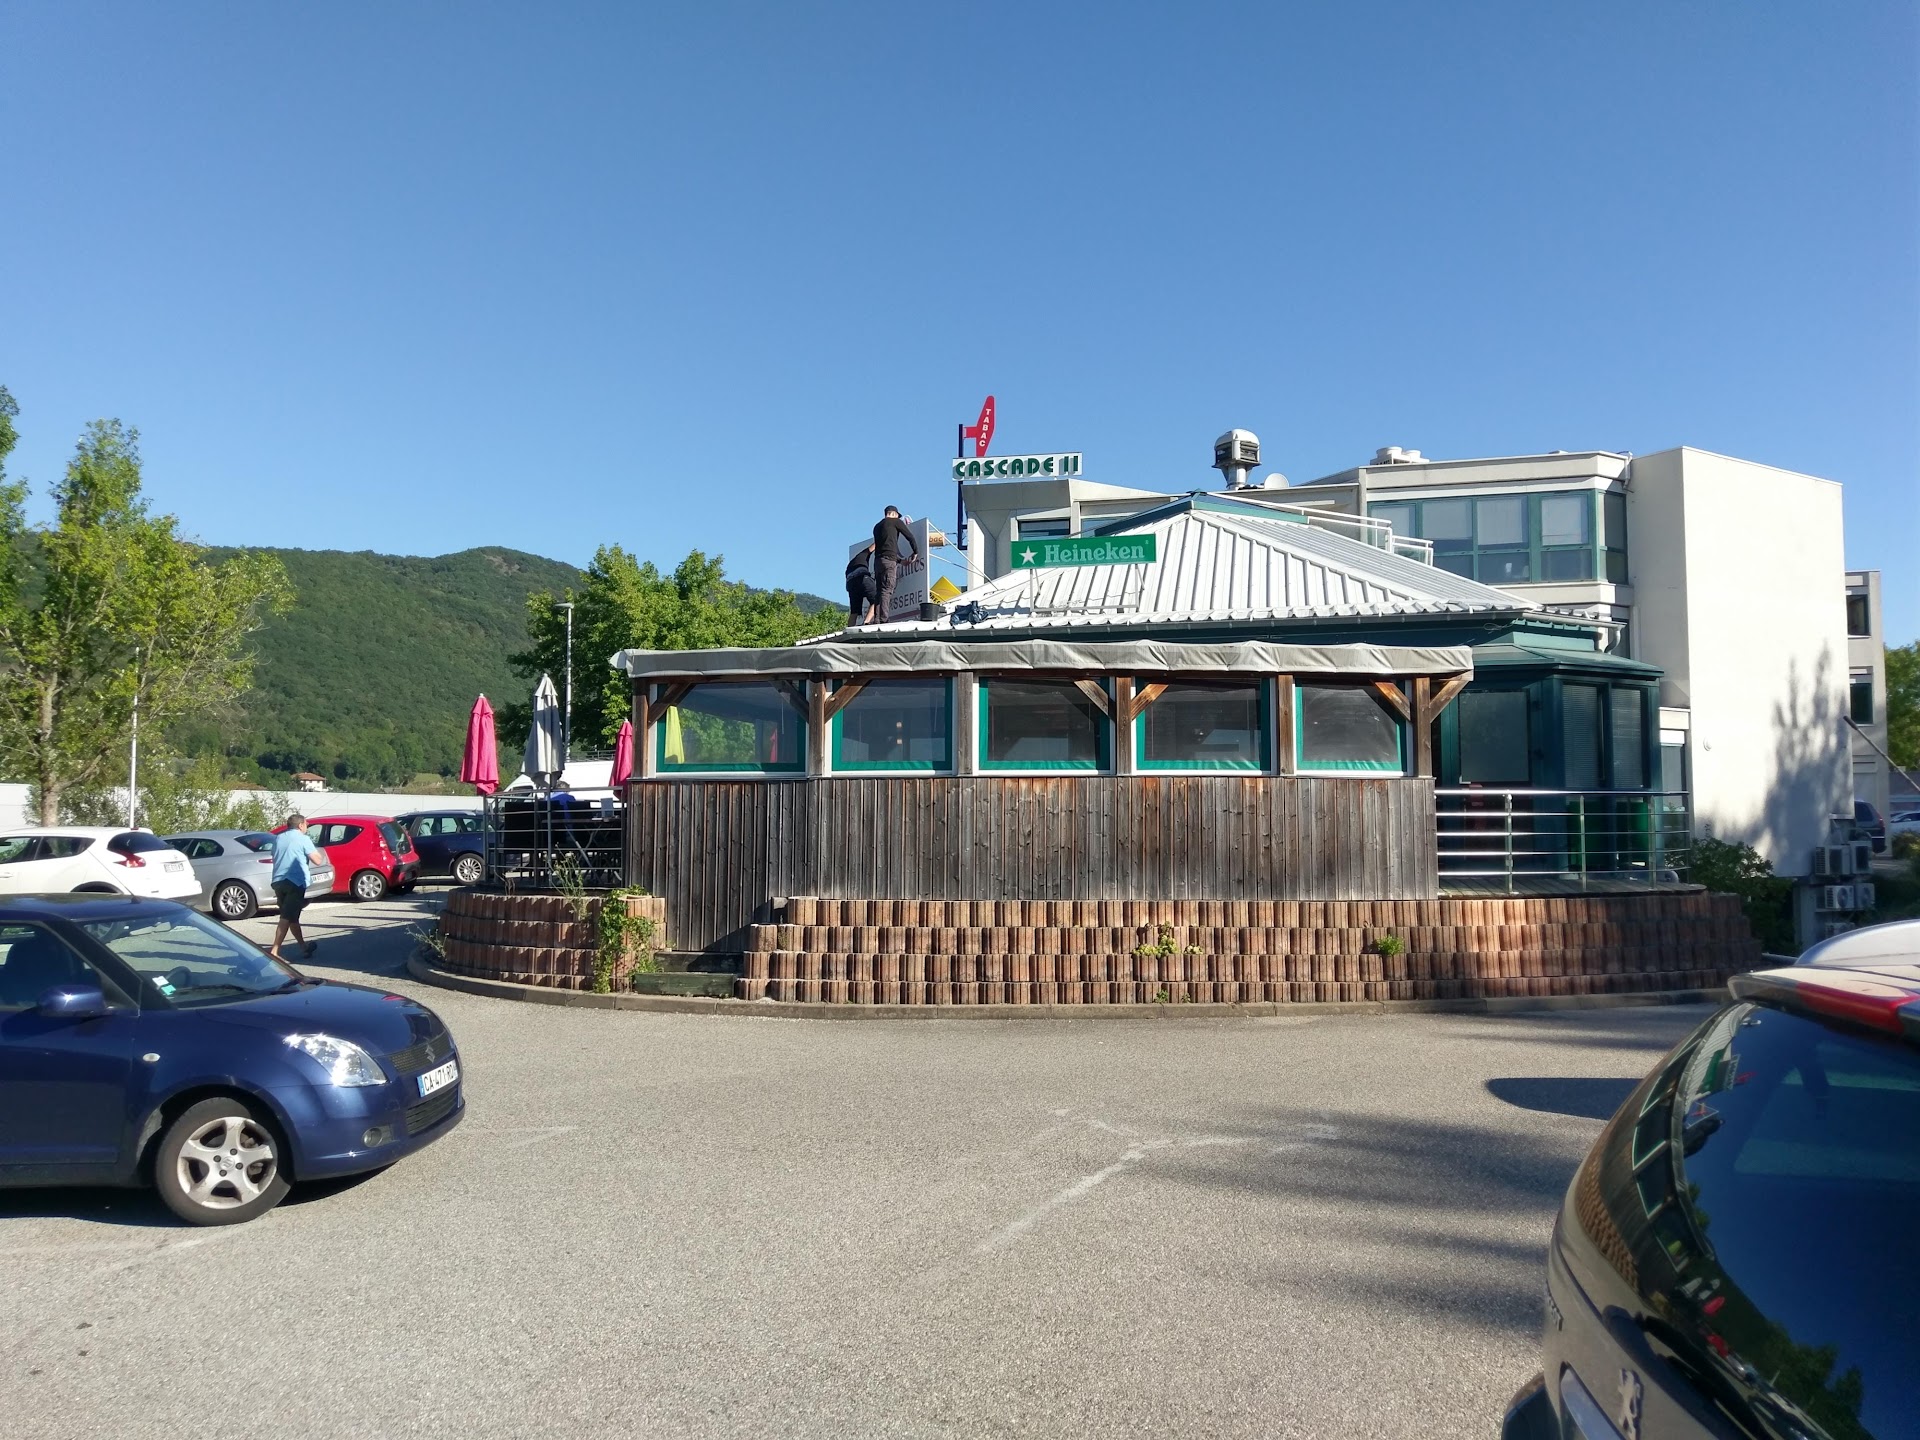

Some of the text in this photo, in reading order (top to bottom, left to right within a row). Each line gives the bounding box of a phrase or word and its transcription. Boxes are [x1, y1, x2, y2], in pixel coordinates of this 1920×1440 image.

[979, 408, 992, 448] TABAC
[955, 456, 1055, 478] CASCADE
[1044, 540, 1146, 565] Heineken
